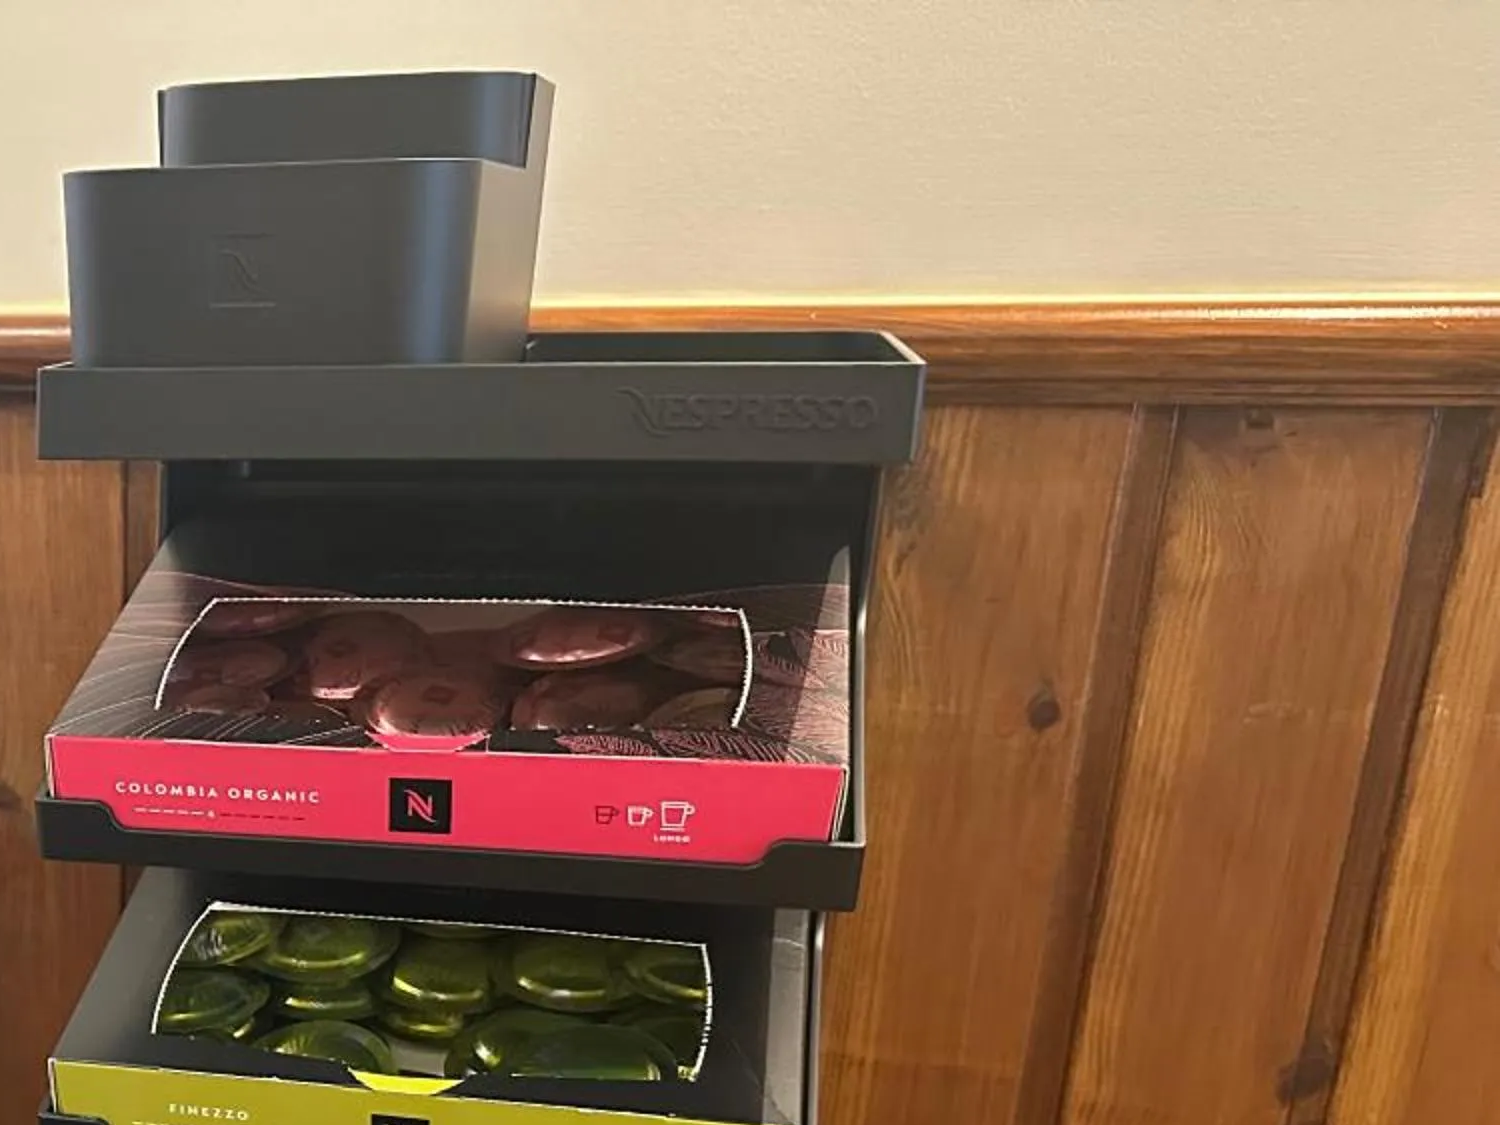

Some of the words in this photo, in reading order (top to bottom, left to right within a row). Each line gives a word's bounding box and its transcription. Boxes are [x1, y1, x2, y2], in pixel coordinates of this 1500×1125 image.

[615, 385, 880, 437] NESPRESSO
[115, 780, 218, 800] COLOMBIA
[227, 786, 320, 804] ORGANIC
[403, 788, 437, 823] N
[169, 1102, 250, 1122] FINEZZO
